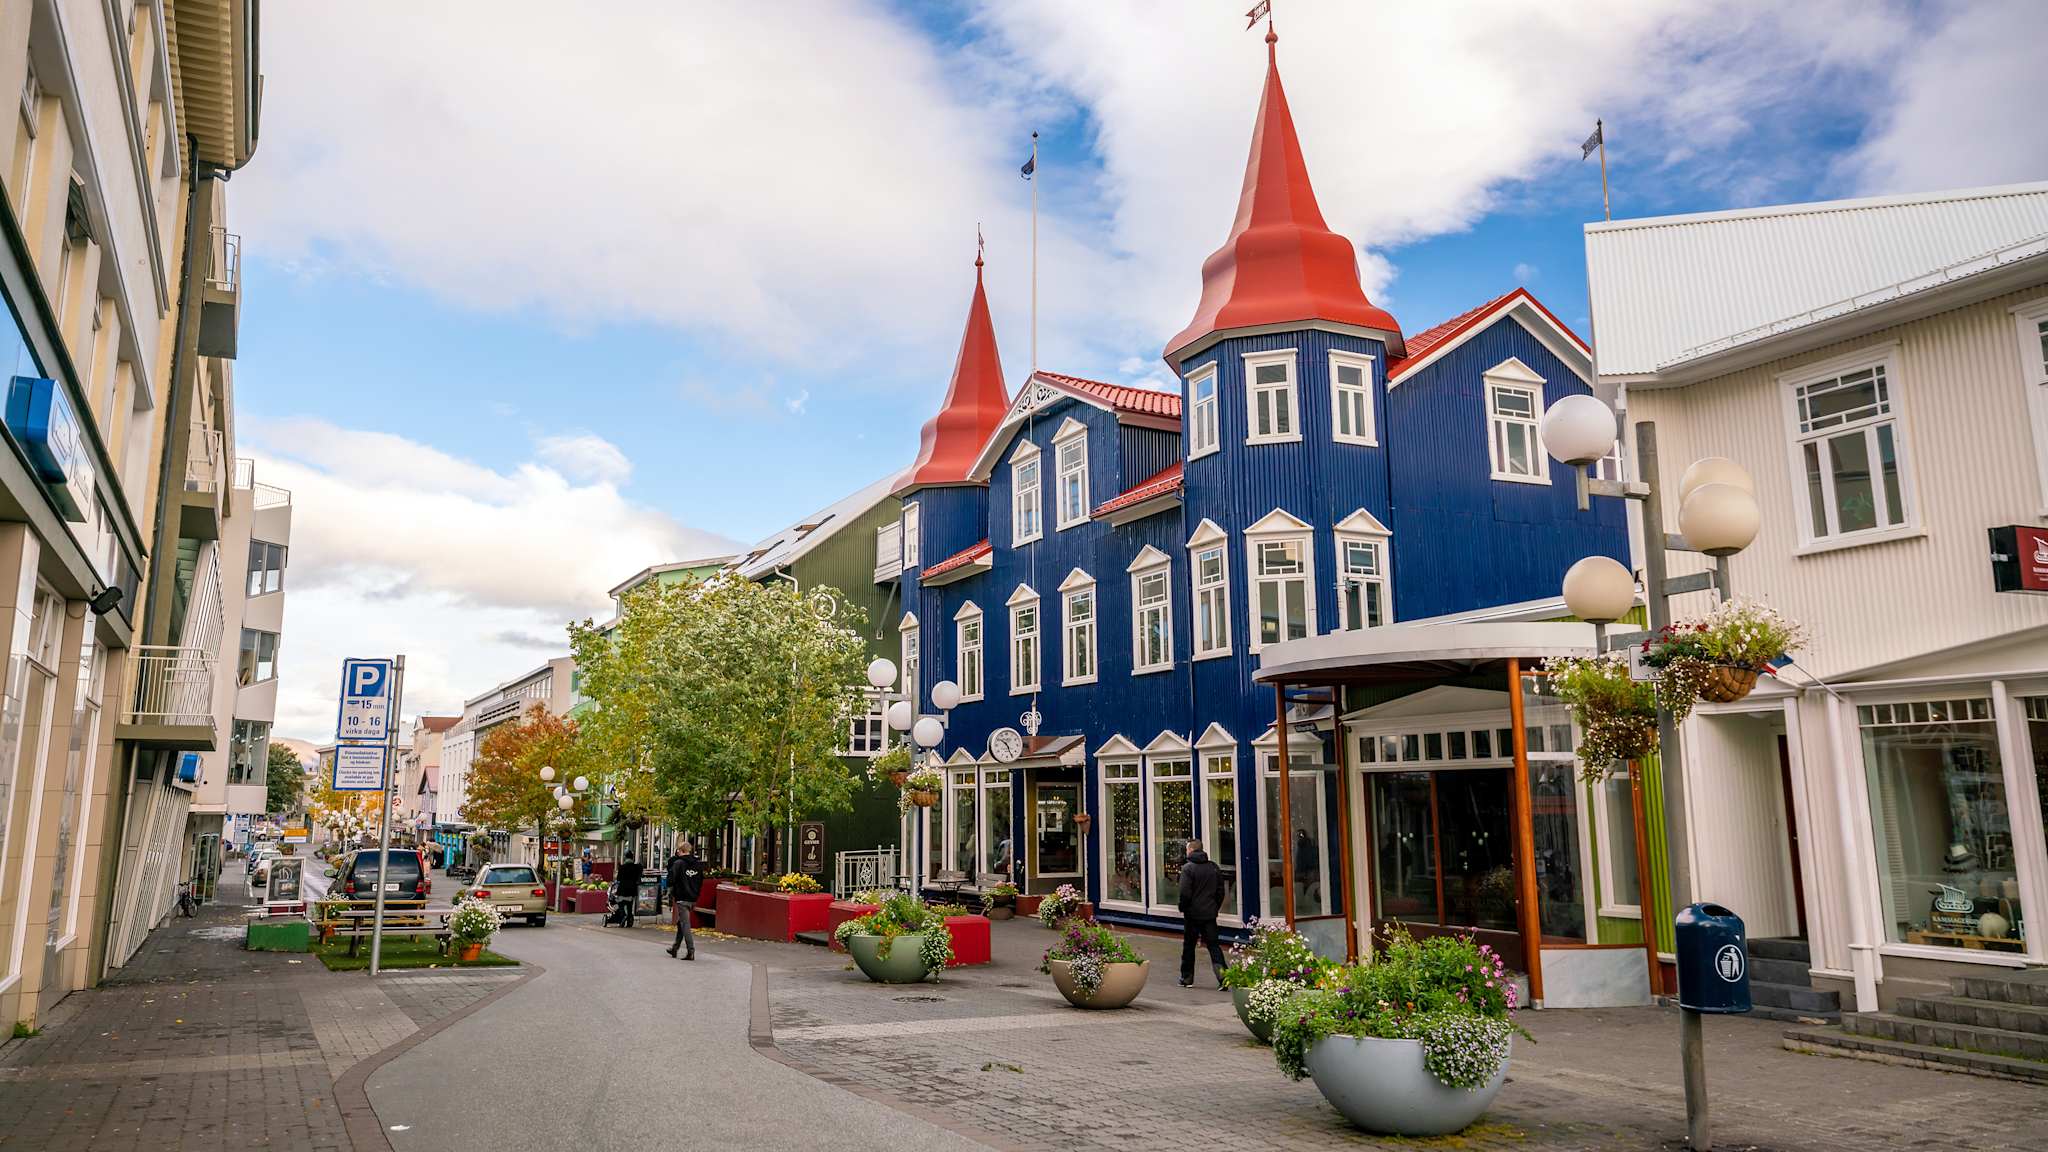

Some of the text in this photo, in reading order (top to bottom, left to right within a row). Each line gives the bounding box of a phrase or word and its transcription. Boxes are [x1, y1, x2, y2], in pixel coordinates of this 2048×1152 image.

[355, 666, 379, 694] P
[361, 699, 372, 709] 15
[347, 716, 359, 726] 10
[369, 716, 381, 726] 16
